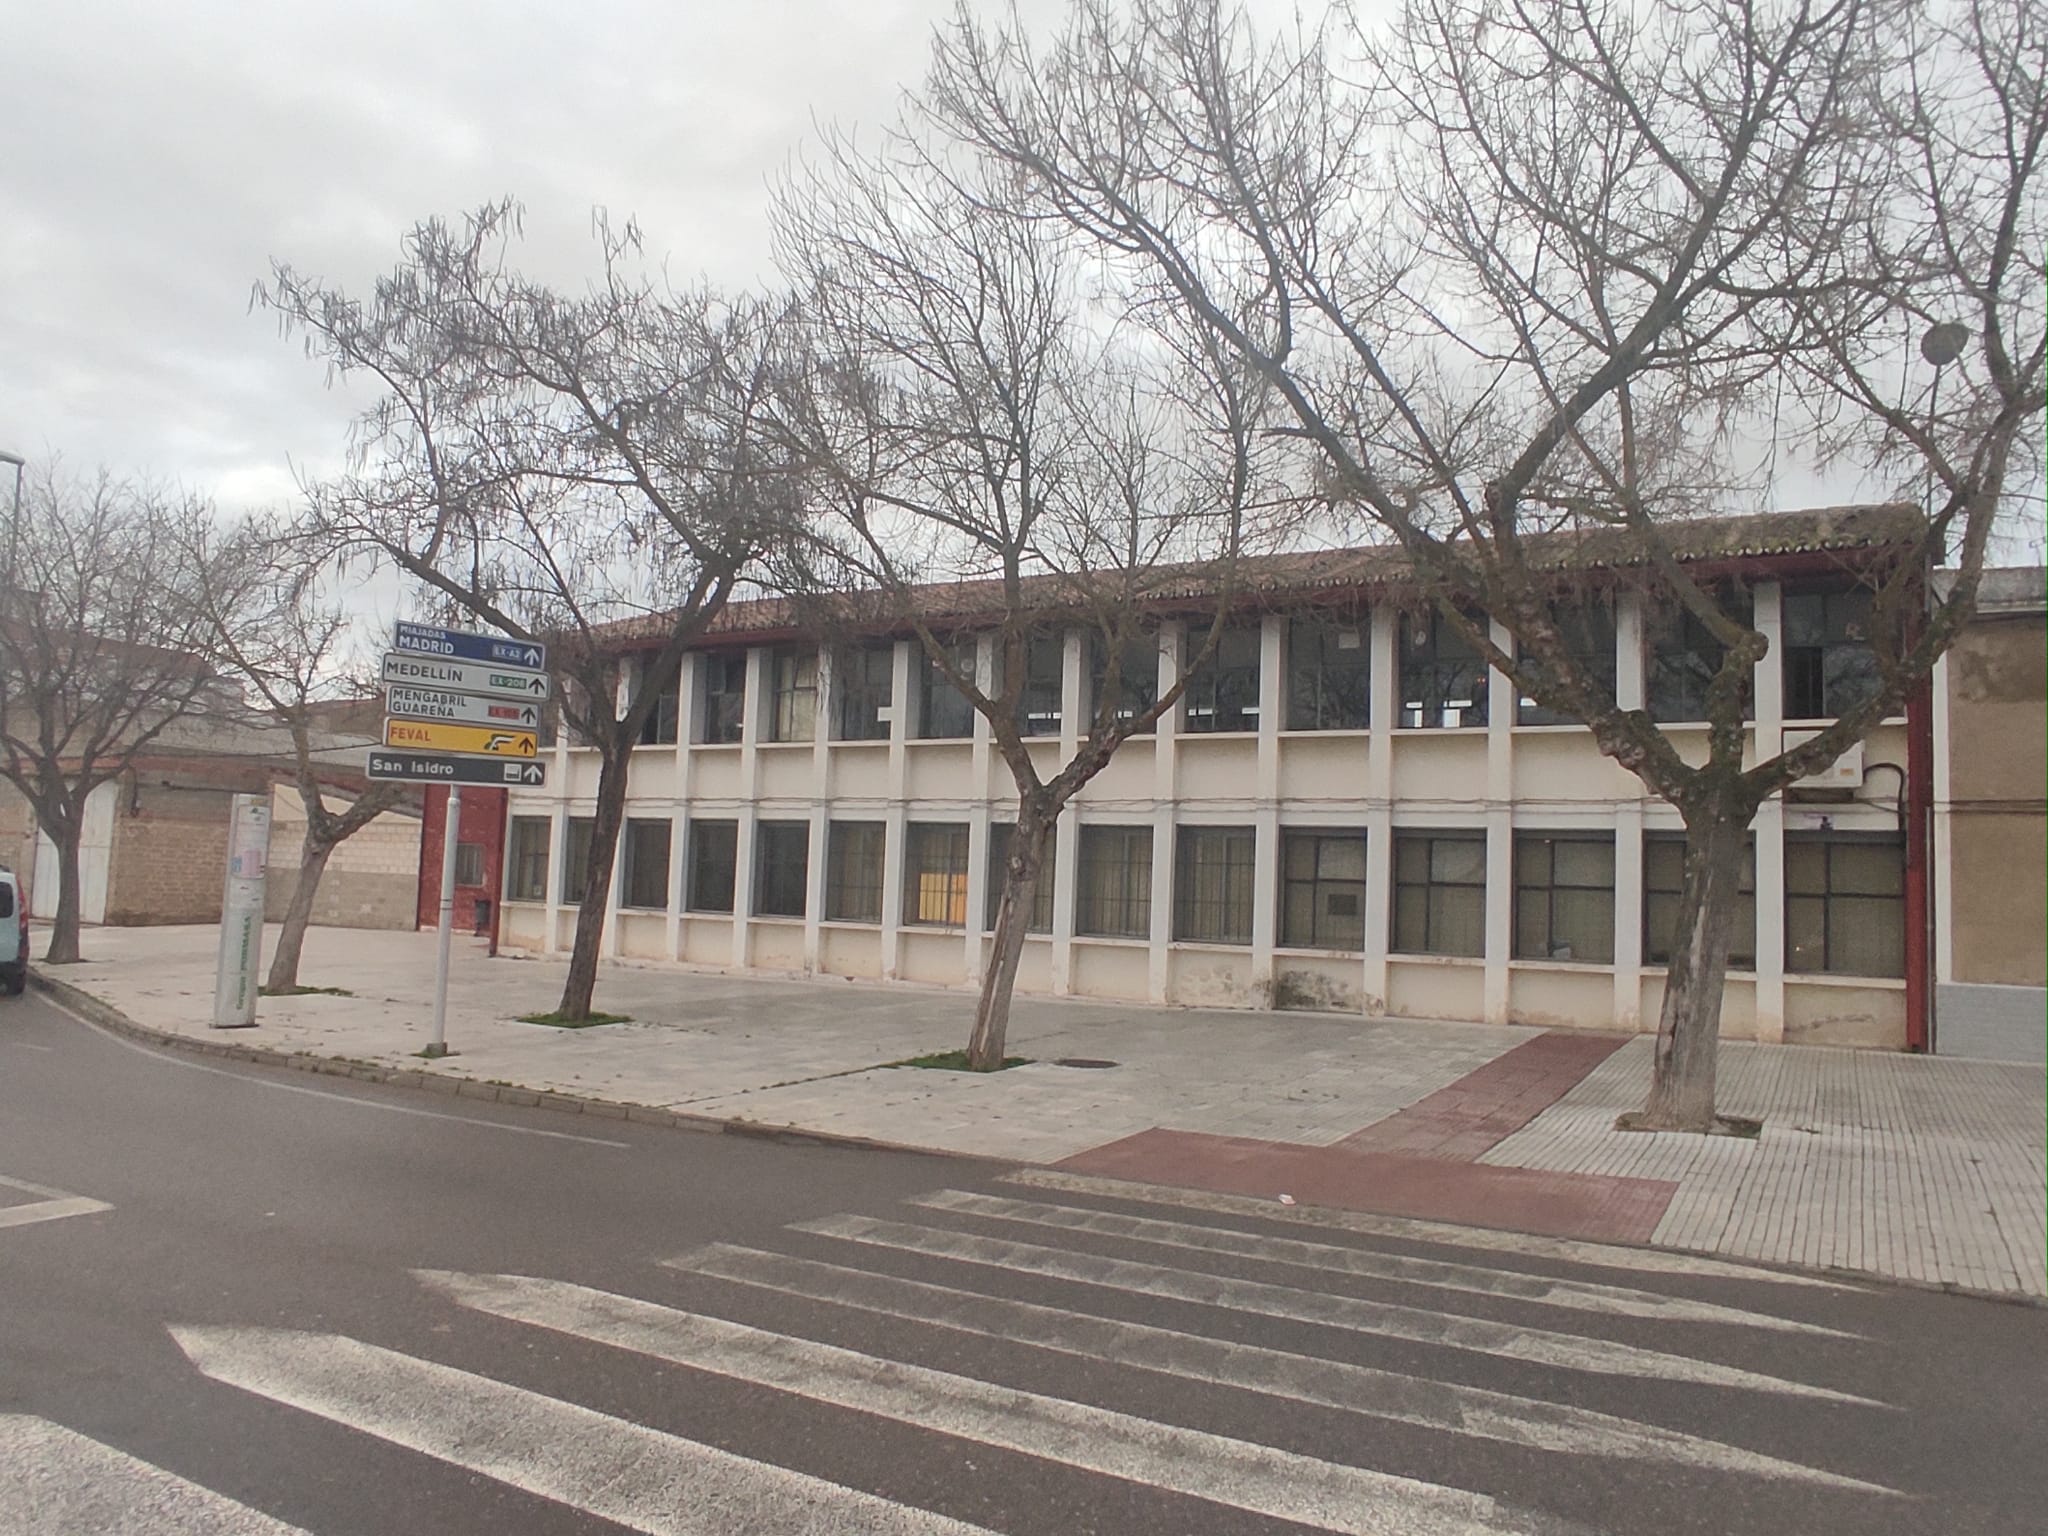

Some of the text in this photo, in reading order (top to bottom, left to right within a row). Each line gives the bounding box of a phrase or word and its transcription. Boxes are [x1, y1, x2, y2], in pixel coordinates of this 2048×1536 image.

[400, 625, 447, 639] MIAJADAS
[399, 635, 455, 654] MADRID
[386, 661, 463, 682] MEDELLÍN
[392, 689, 467, 707] MENGABRIL
[390, 726, 432, 742] FEVAL
[372, 759, 454, 775] San Isidro
